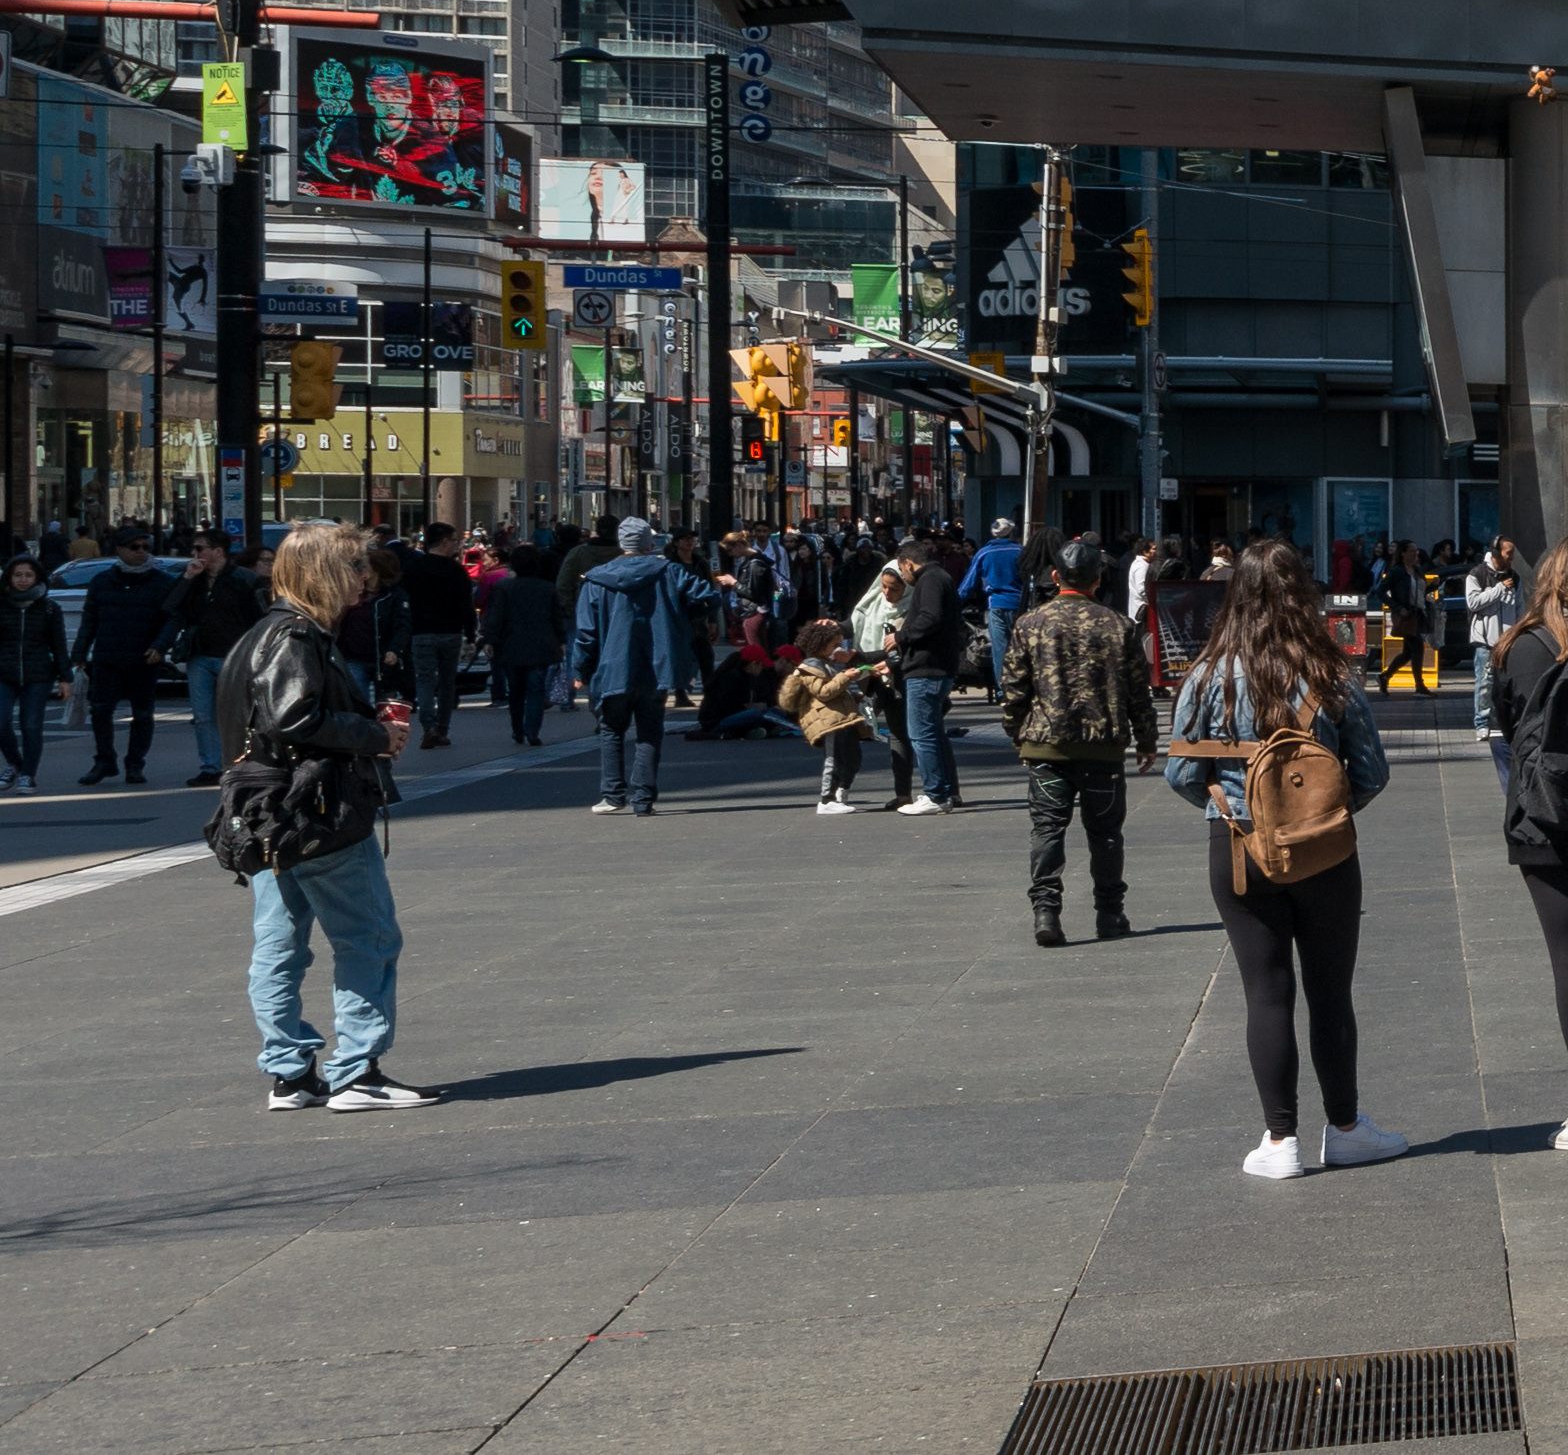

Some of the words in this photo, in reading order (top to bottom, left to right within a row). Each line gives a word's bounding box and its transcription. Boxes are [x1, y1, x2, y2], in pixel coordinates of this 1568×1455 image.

[209, 67, 240, 79] NOTICE
[709, 64, 724, 180] DOWNTOWN
[585, 269, 648, 284] Dundas
[654, 269, 663, 277] St
[110, 299, 148, 315] THE
[268, 298, 322, 315] Dundas
[326, 301, 337, 314] St
[340, 300, 348, 314] E
[642, 409, 653, 455] ALDO
[669, 414, 681, 459] ALDO
